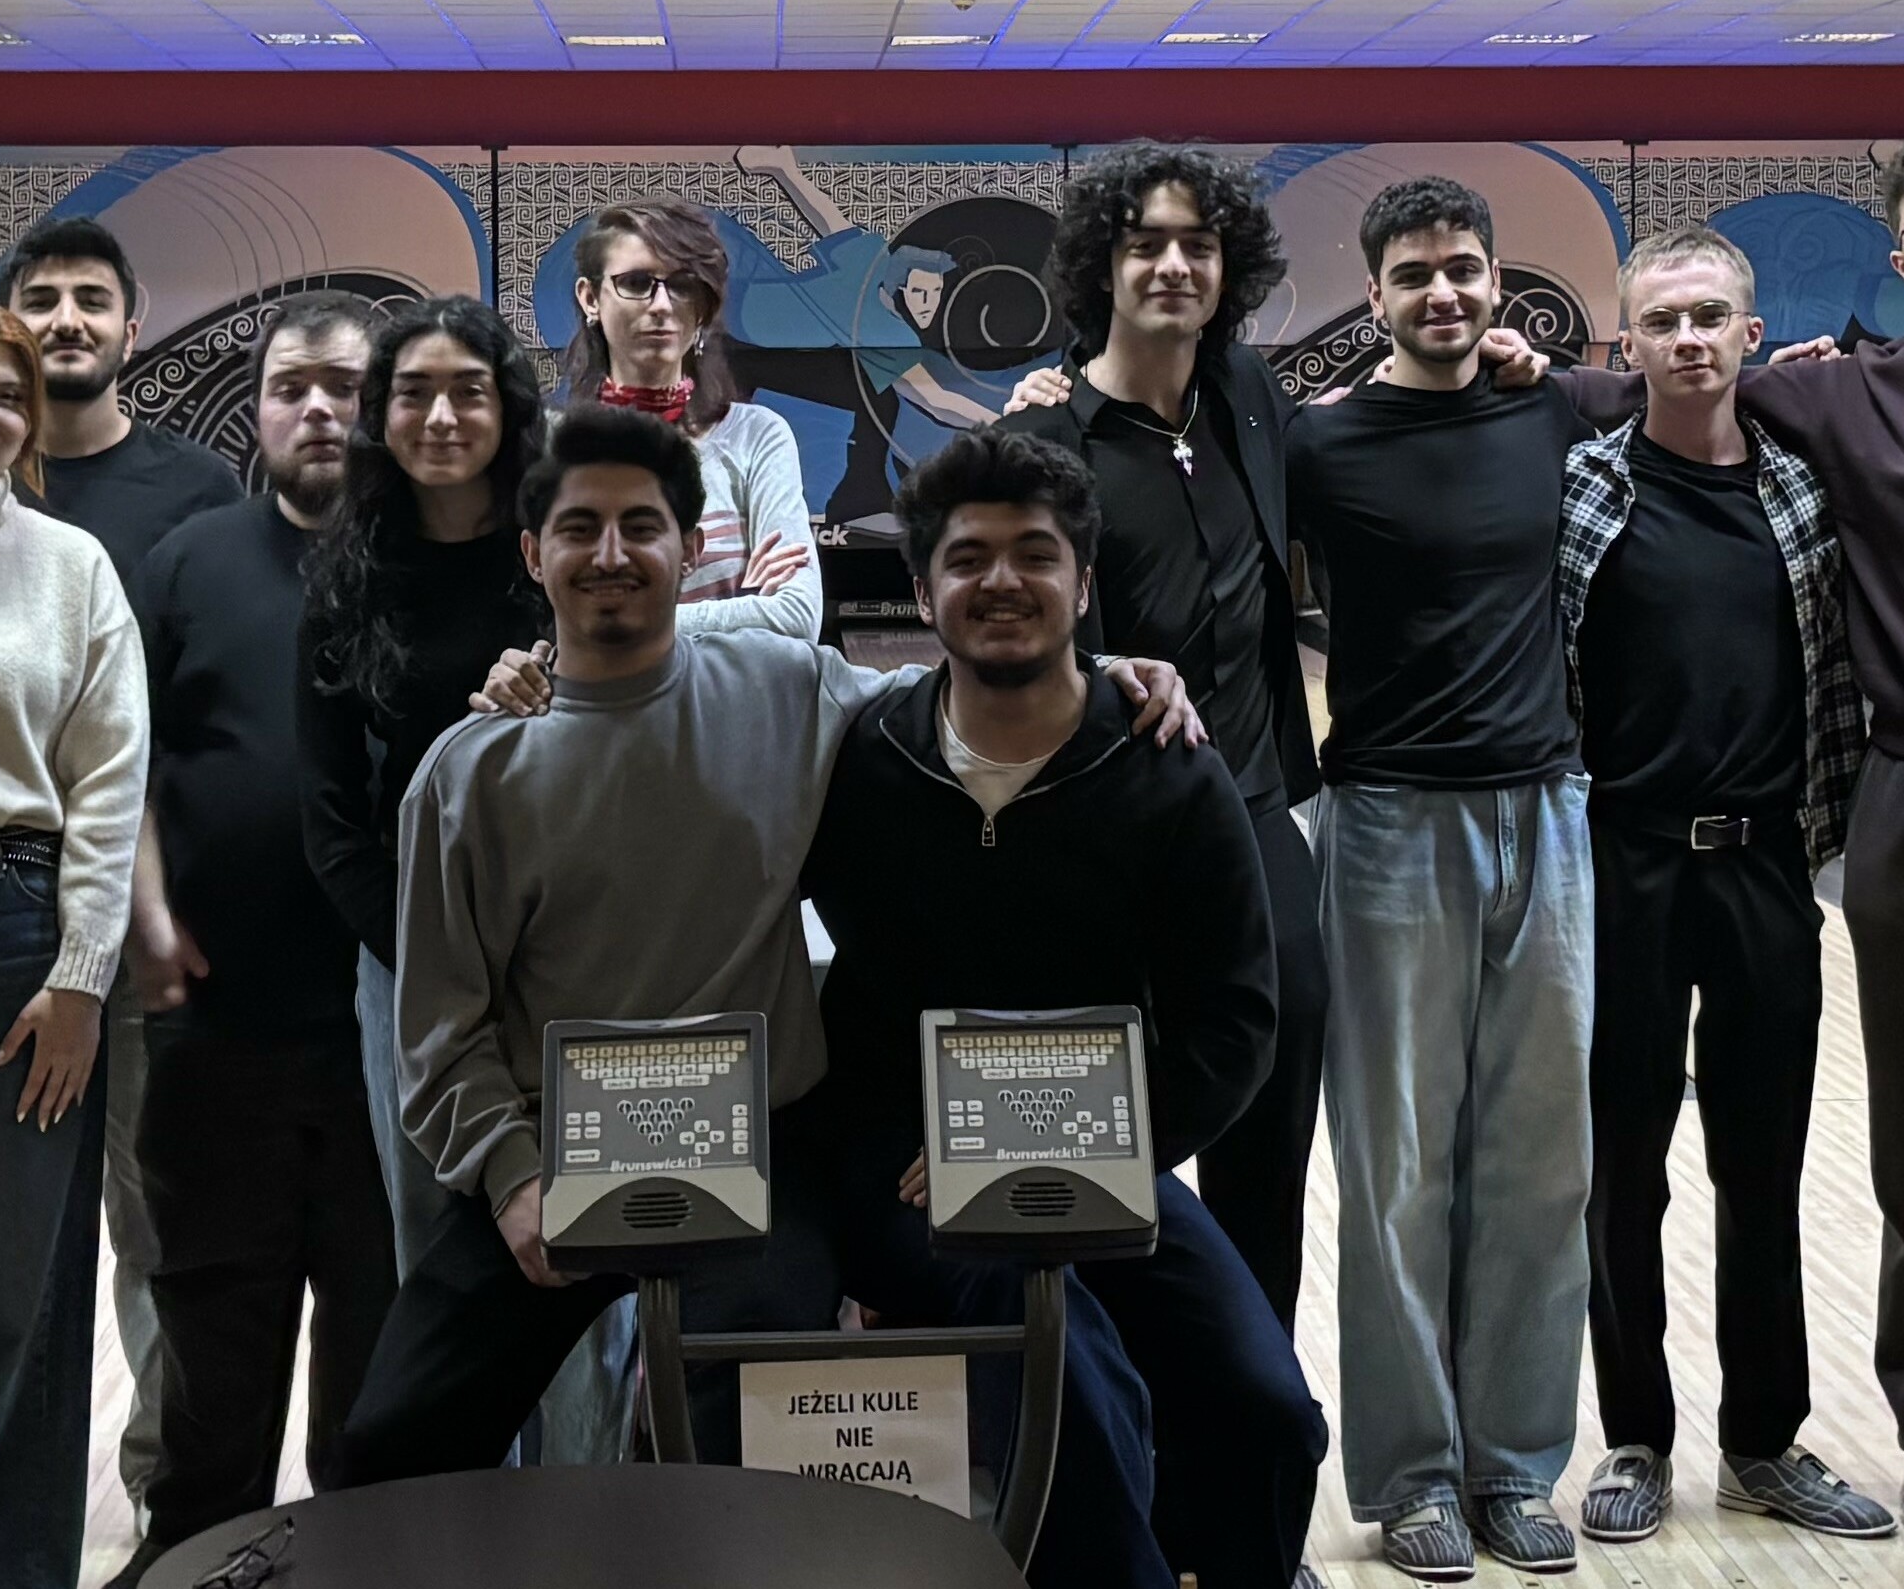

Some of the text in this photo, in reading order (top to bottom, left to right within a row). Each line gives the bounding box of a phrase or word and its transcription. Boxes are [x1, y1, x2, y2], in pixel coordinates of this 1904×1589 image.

[996, 1147, 1073, 1161] Brunswick
[610, 1157, 688, 1173] Brunswick
[787, 1390, 919, 1415] JEŻELI KULE
[836, 1427, 874, 1448] NIE
[799, 1460, 913, 1484] WRACAJĄ
